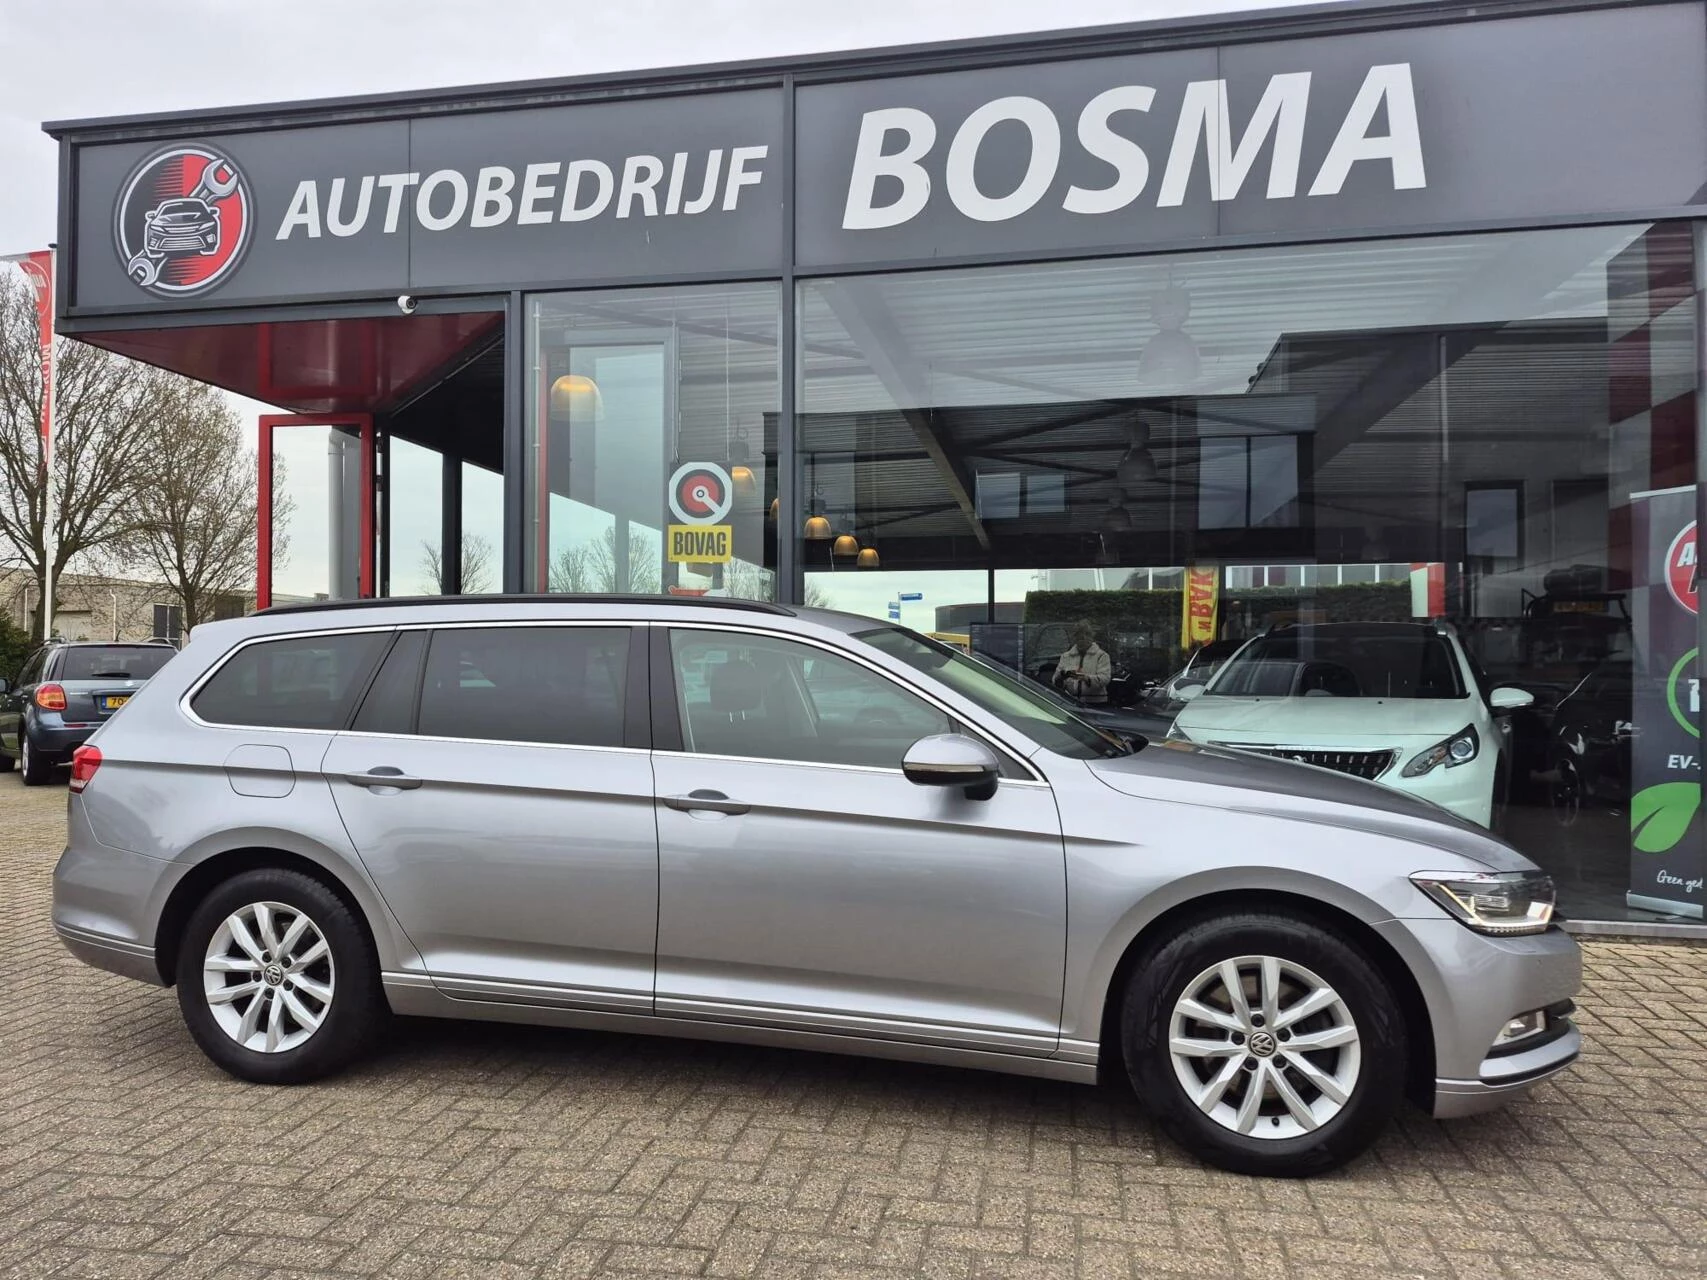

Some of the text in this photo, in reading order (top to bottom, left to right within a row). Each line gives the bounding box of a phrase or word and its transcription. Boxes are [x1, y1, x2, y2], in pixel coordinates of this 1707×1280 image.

[842, 62, 1427, 230] BOSMA
[275, 145, 769, 241] AUTOBEDRIJF
[673, 531, 727, 556] BOVAG
[1667, 754, 1702, 771] EV-
